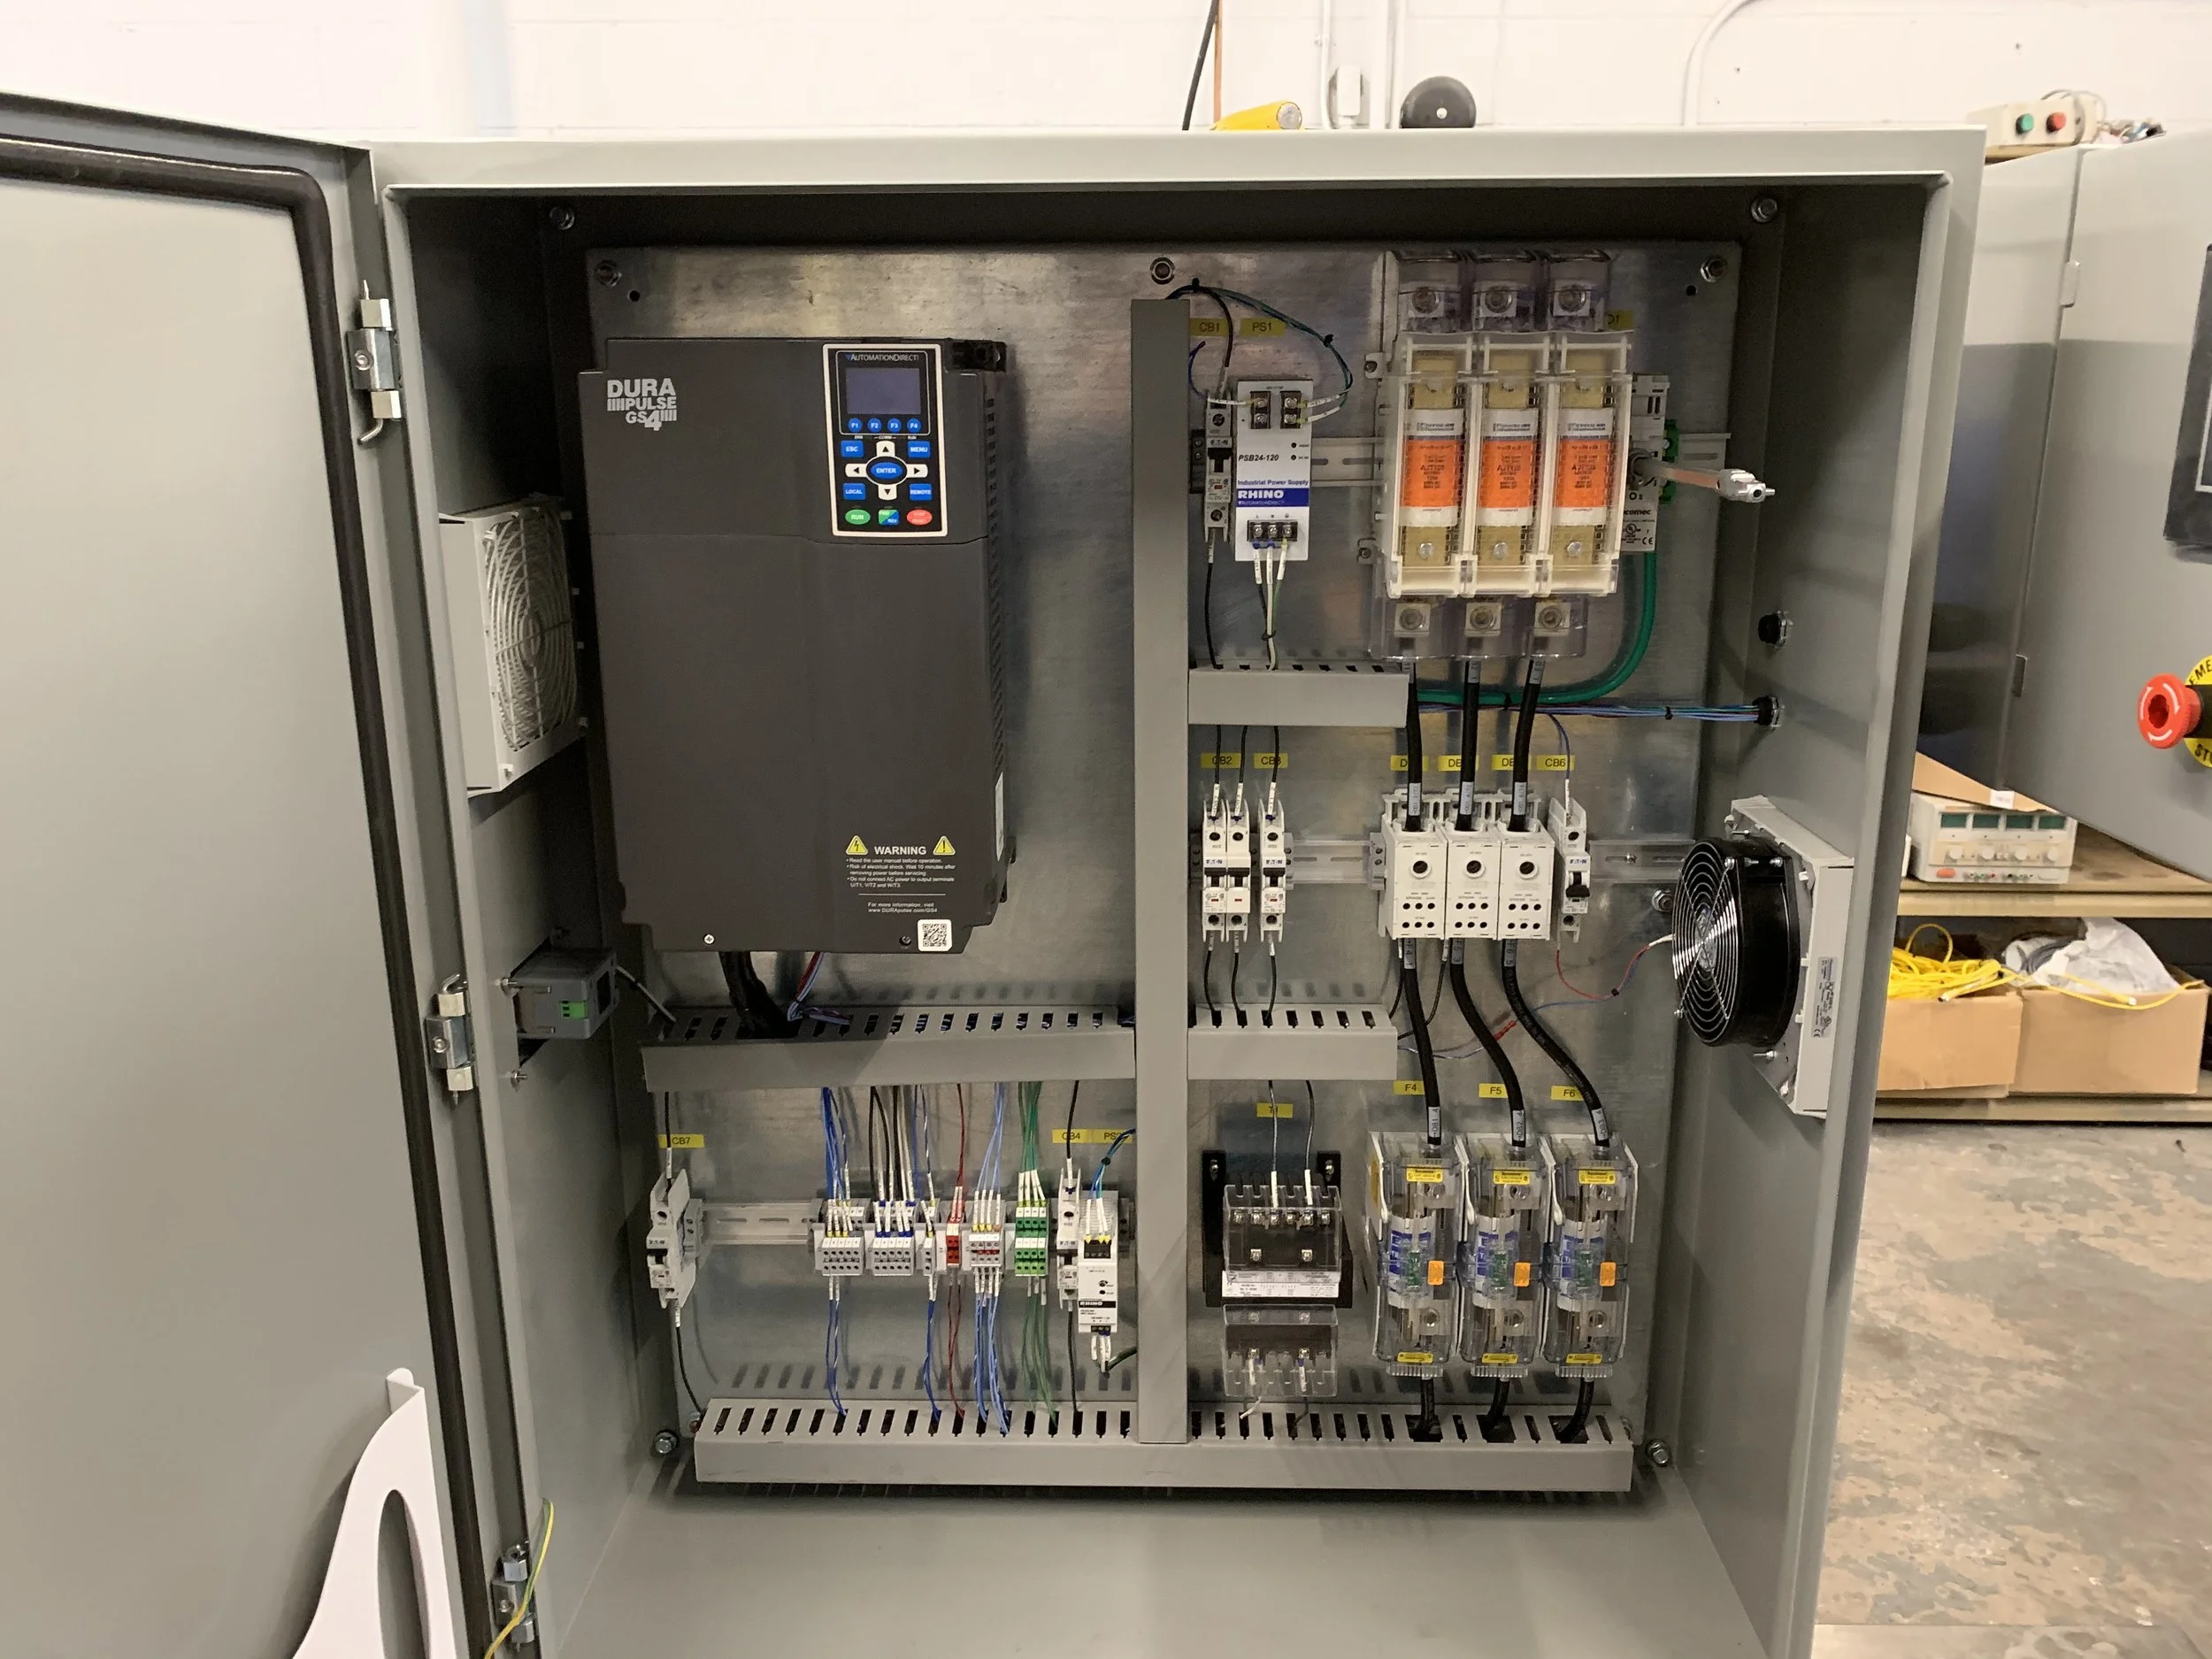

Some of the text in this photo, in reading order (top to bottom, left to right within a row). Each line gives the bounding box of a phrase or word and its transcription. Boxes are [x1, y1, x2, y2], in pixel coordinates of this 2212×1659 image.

[1199, 322, 1220, 332] CB1
[1252, 322, 1271, 332] PS1
[607, 378, 676, 398] DURA
[625, 396, 677, 411] PULSE
[626, 410, 663, 431] GS4
[1238, 489, 1284, 499] RHINO
[1545, 757, 1565, 766] CB6
[874, 846, 926, 855] WARNING
[1405, 1083, 1417, 1092] F4
